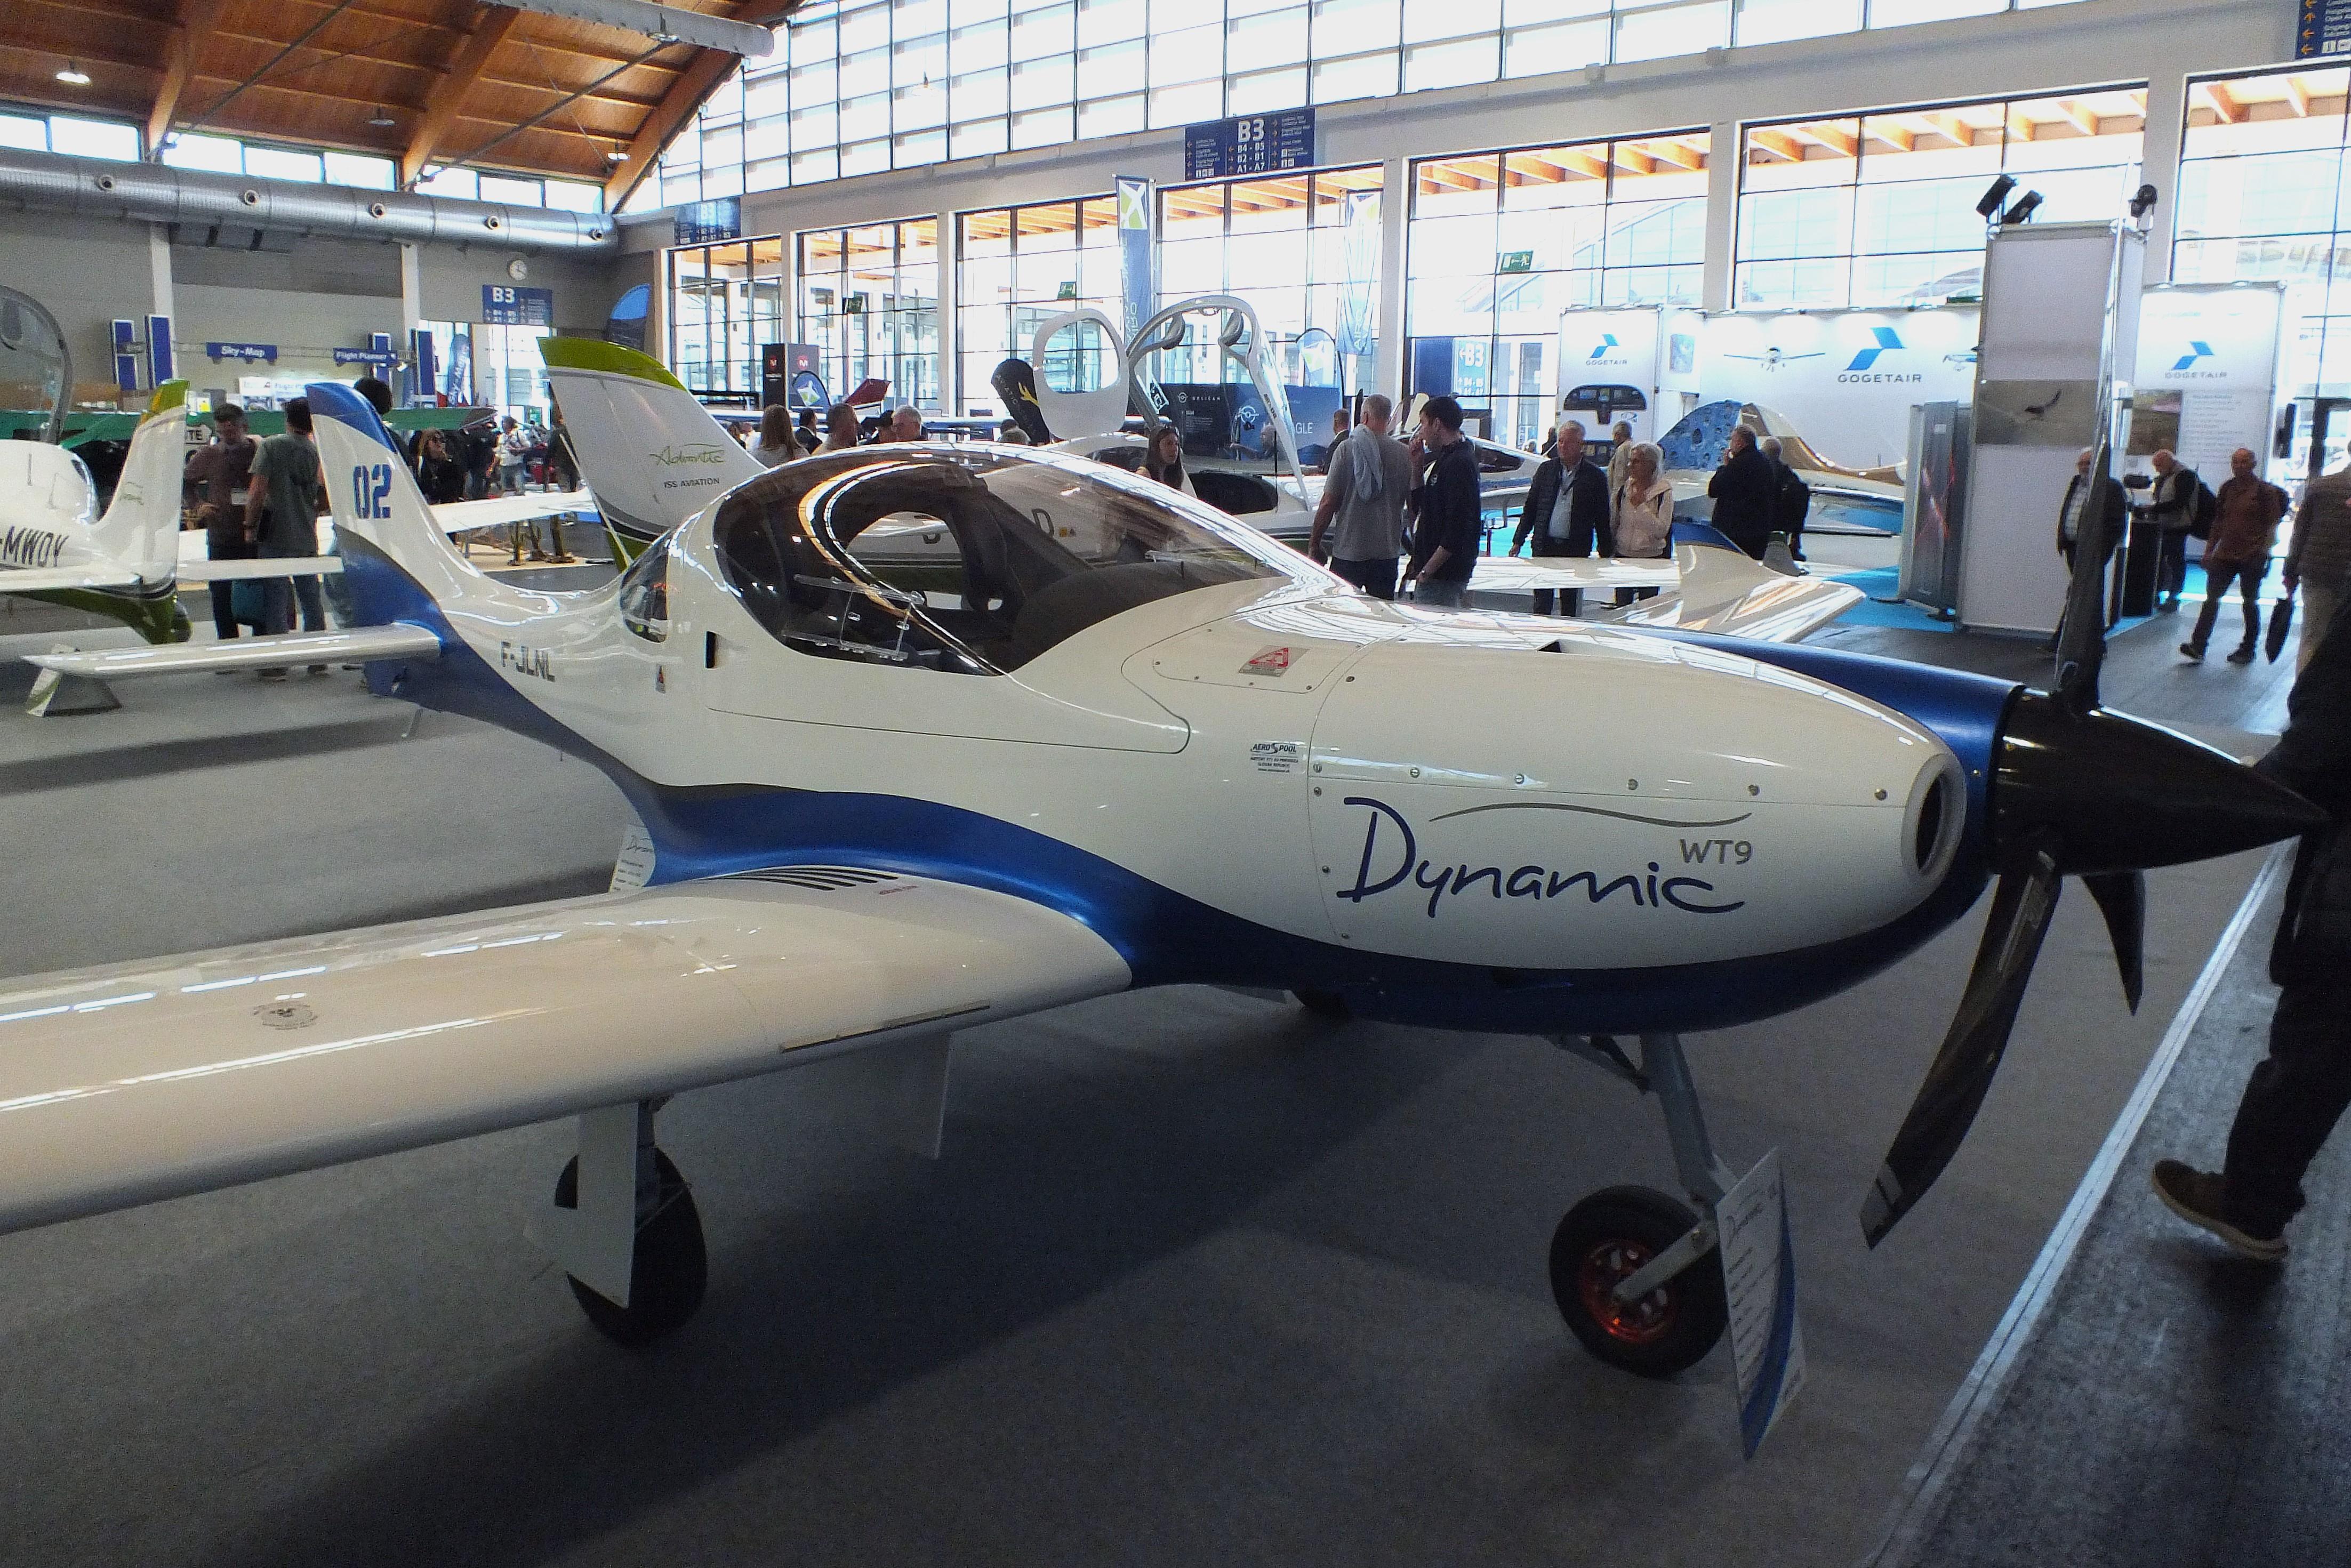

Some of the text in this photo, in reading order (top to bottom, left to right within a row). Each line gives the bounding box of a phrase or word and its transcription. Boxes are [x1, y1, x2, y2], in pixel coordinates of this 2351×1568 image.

[1238, 118, 1265, 143] B3
[1237, 163, 1247, 174] A1
[492, 287, 515, 304] B3
[1465, 343, 1485, 367] B3
[1838, 374, 1922, 383] GOGETAIR
[353, 464, 392, 519] 02
[680, 477, 720, 487] AVIATION
[1336, 797, 1745, 918] Dynamic
[1679, 839, 1752, 865] WT9
